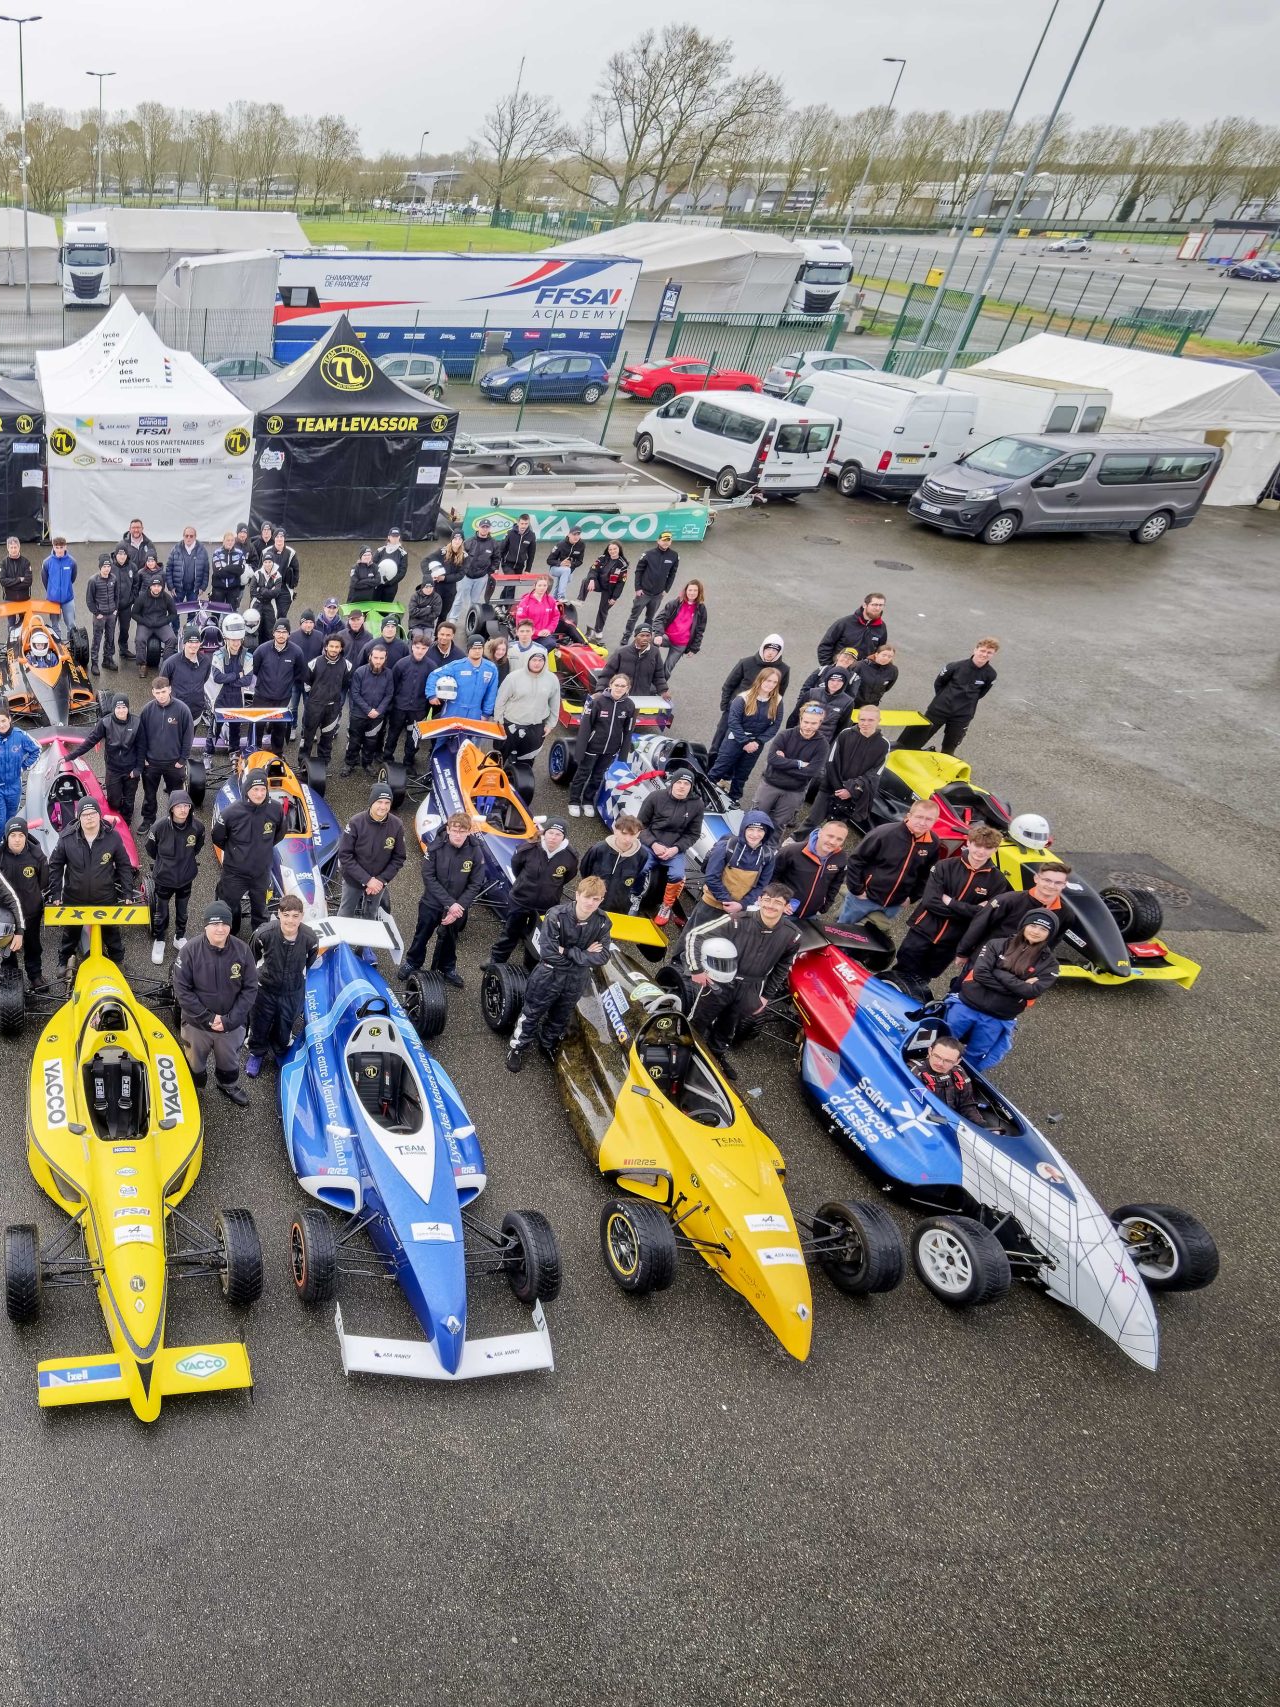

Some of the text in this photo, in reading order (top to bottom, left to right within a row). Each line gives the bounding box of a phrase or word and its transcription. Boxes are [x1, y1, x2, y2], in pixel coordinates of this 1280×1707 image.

[535, 288, 610, 305] FFSA
[532, 309, 617, 319] ACADEMY
[118, 357, 138, 366] lycée
[297, 416, 419, 432] TEAM LEVASSOR
[528, 512, 659, 541] YACCO
[55, 907, 136, 922] ixell
[305, 989, 317, 1012] Lycée
[600, 989, 628, 1043] Norauto
[318, 1055, 329, 1078] entre
[418, 1051, 433, 1076] entre
[45, 1062, 66, 1125] YACCO
[157, 1057, 179, 1121] YACCO
[858, 1076, 892, 1112] Saint
[322, 1078, 337, 1119] Meurthe
[829, 1095, 880, 1144] d'Assise
[845, 1085, 896, 1140] François
[440, 1114, 452, 1132] des
[394, 1145, 426, 1156] TEAM
[711, 1137, 743, 1148] TEAM
[461, 1166, 476, 1174] RRS
[634, 1158, 657, 1166] RRS
[328, 1167, 349, 1176] RRS
[114, 1208, 147, 1218] FFSA
[181, 1359, 223, 1371] YACCO
[67, 1369, 88, 1382] ixell
